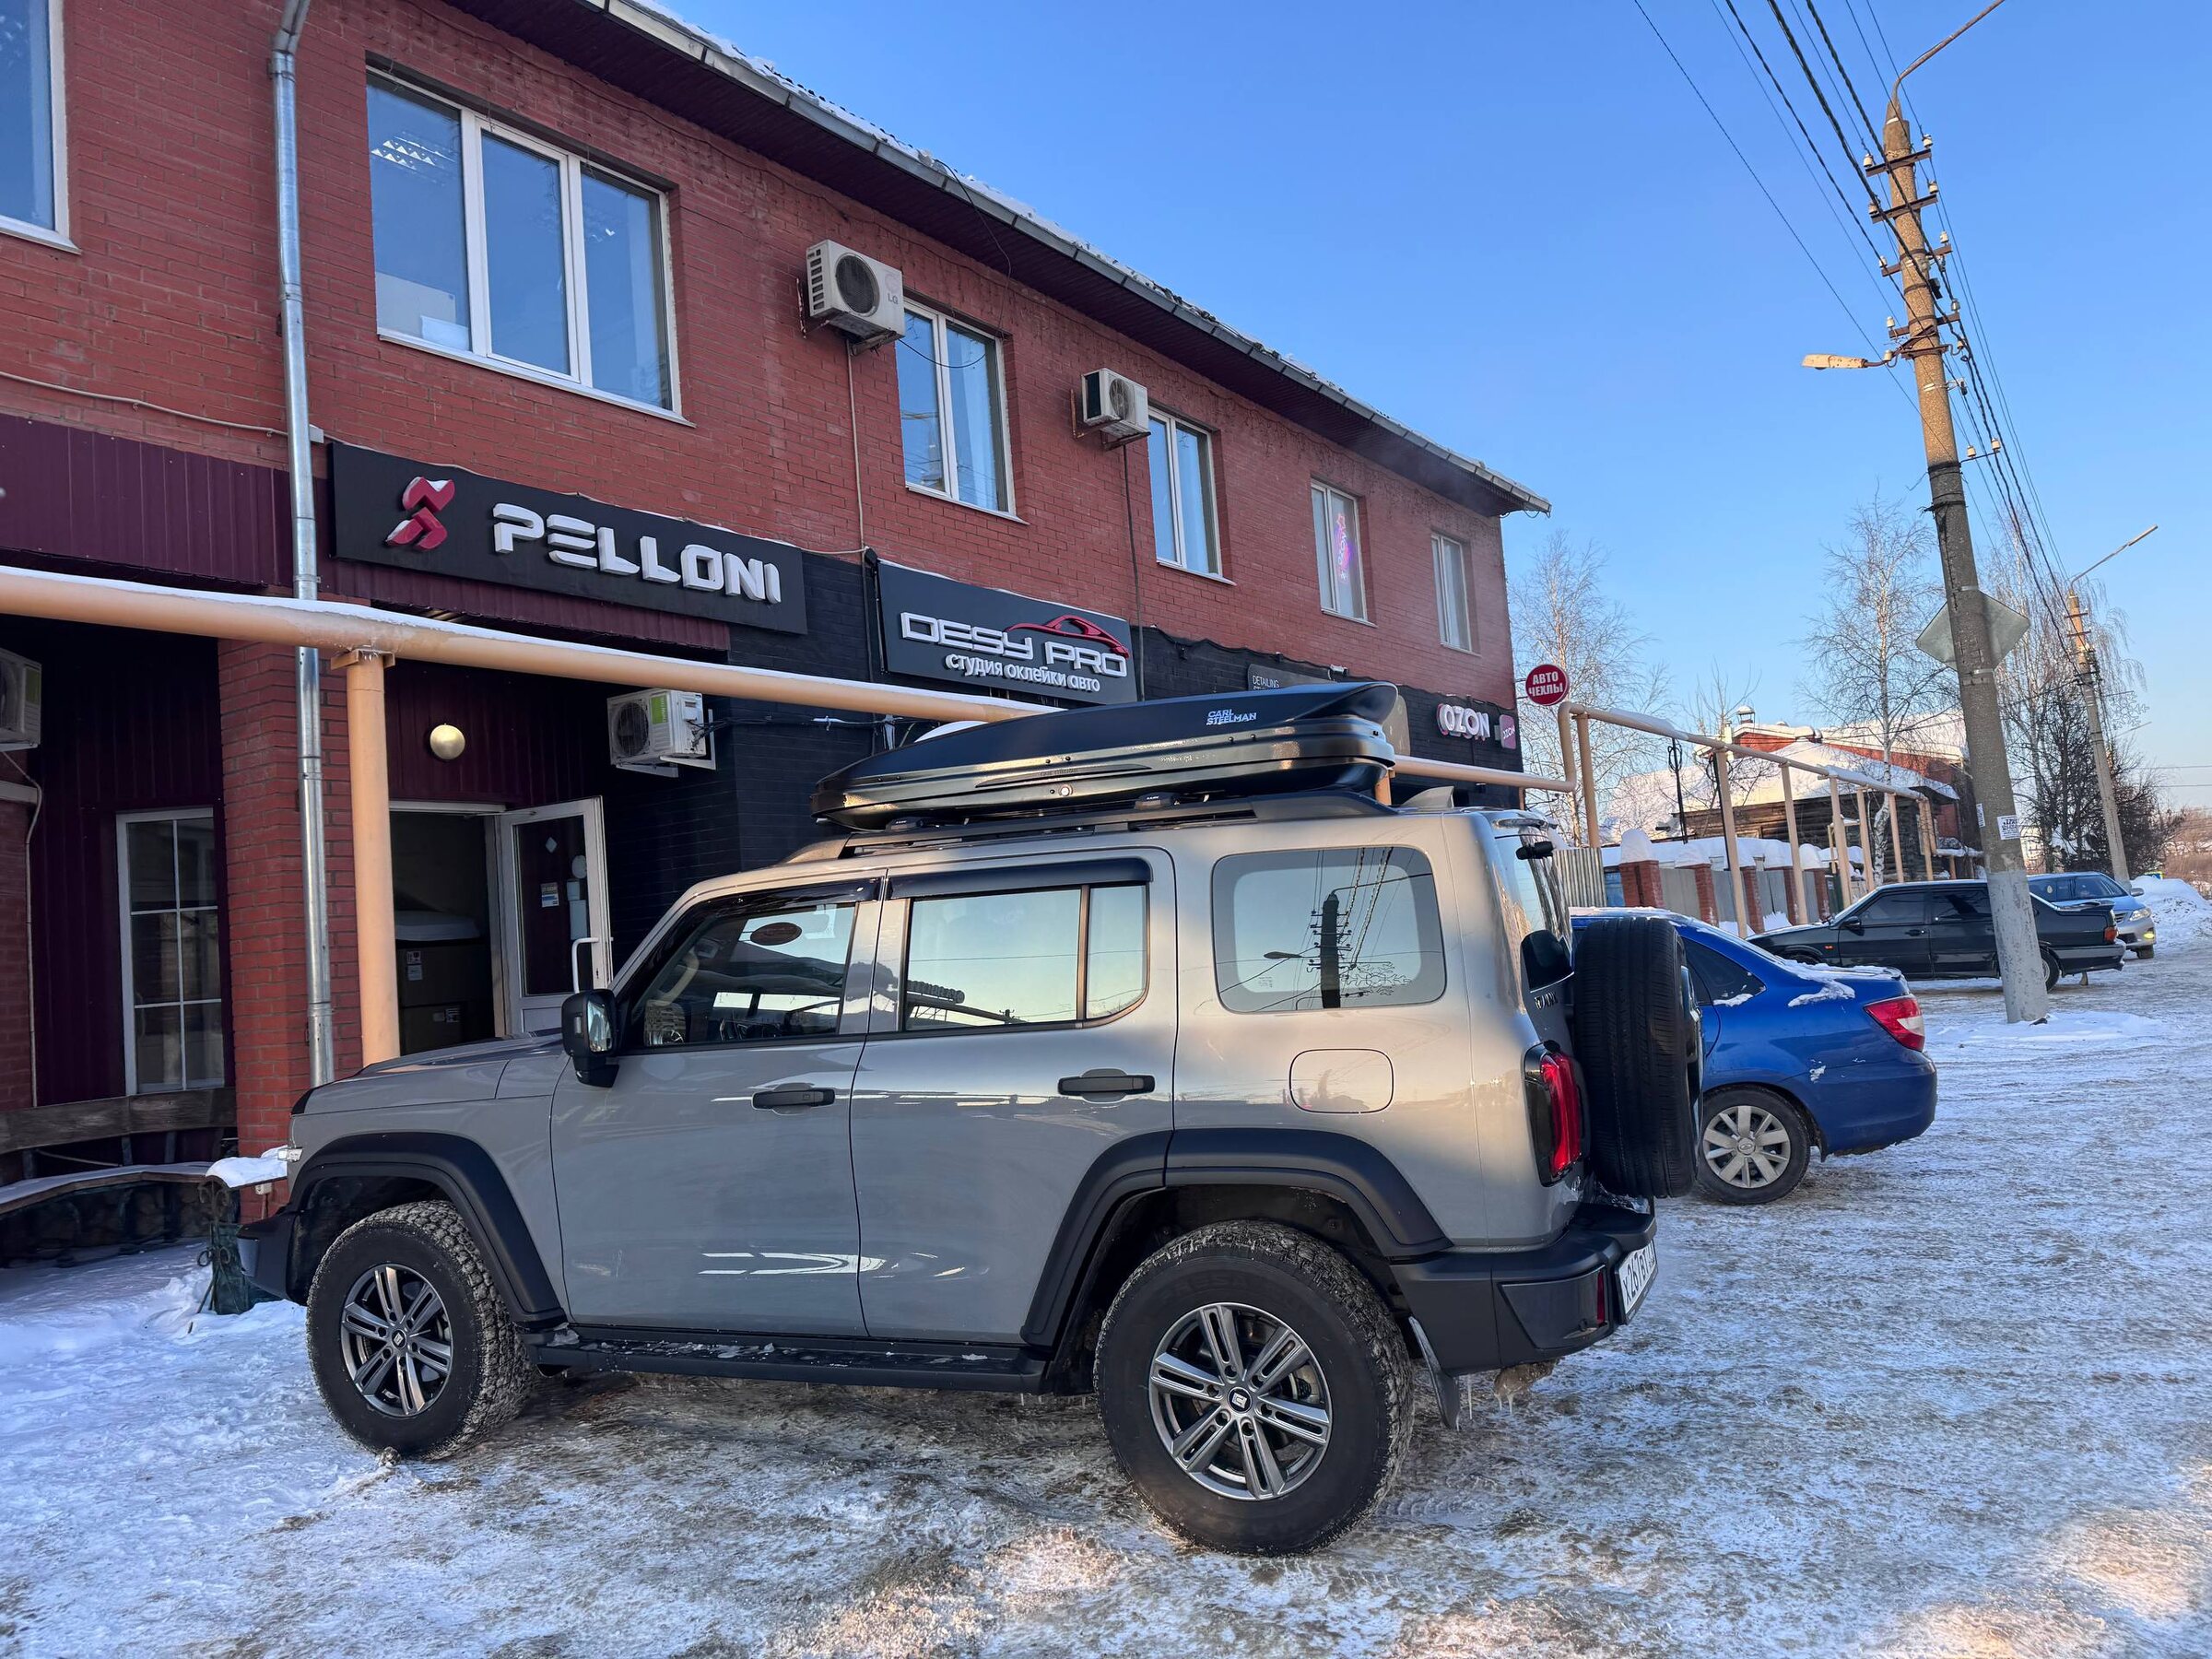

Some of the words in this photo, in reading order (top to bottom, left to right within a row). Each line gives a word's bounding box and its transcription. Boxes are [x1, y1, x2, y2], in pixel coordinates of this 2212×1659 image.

[492, 502, 782, 604] PELLONI
[900, 612, 1033, 660] DESY
[1044, 641, 1127, 677] PRO
[945, 653, 1003, 677] студия
[1004, 664, 1066, 688] оклейки
[1067, 676, 1100, 692] авто
[1532, 671, 1559, 685] АВТО
[1253, 675, 1280, 688] DETAILING
[1528, 683, 1563, 697] ЧЕХЛЫ
[1206, 712, 1257, 725] STEELMAN
[1207, 709, 1234, 718] CARL
[1438, 703, 1490, 740] OZON
